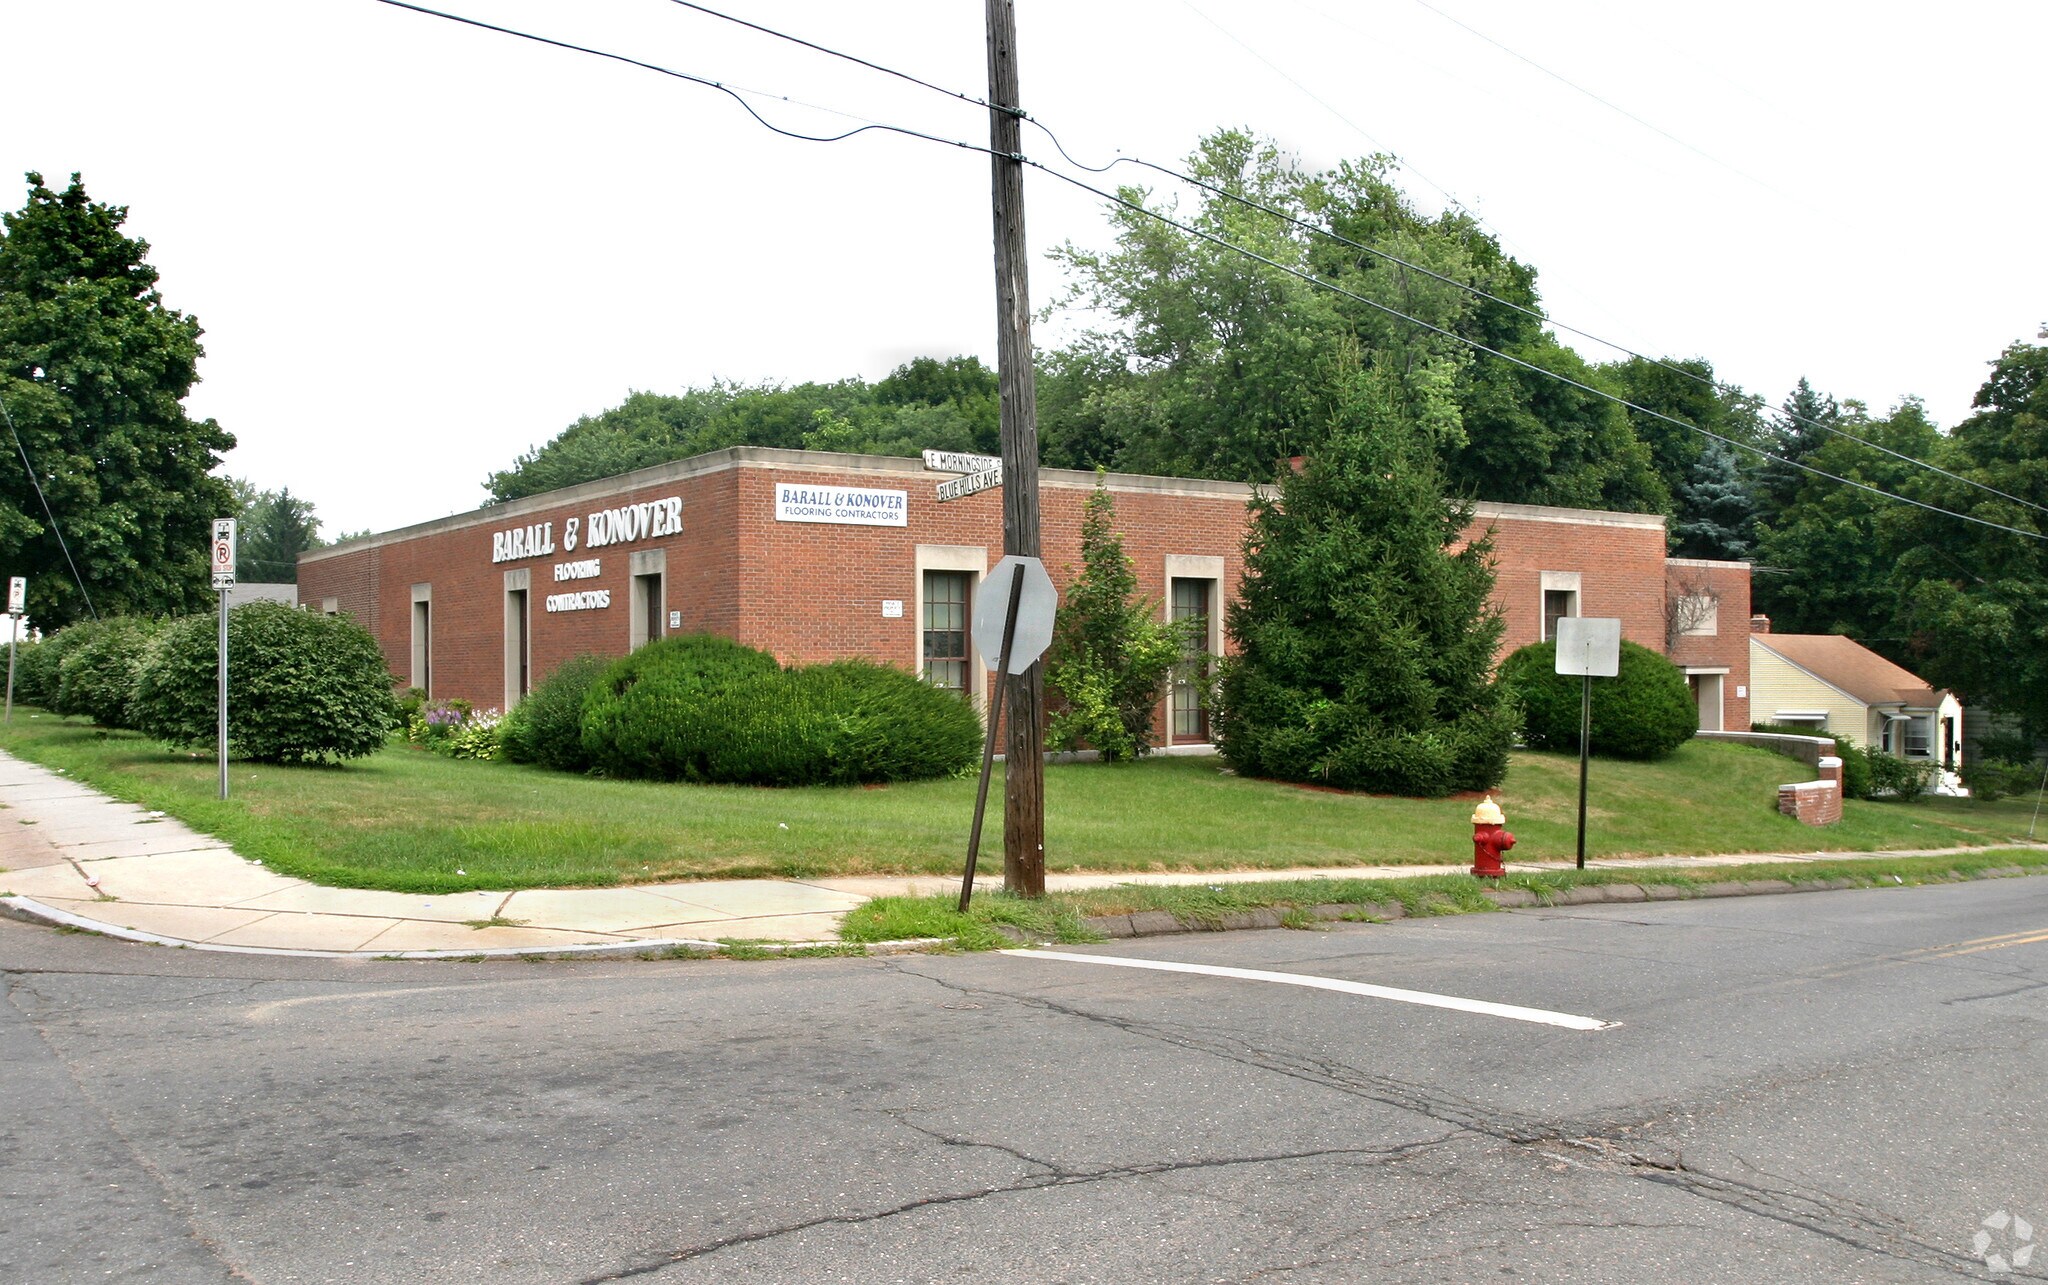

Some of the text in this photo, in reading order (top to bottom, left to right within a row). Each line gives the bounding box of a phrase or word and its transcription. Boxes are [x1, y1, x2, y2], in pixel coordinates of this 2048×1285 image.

[940, 453, 992, 472] MORNINGSIDE
[781, 489, 903, 509] BARALL & KONOVER
[939, 481, 958, 500] BLUE
[960, 474, 981, 494] HILLS
[785, 506, 899, 521] FLOORING CONTRACTORS
[492, 496, 684, 564] BARALL & KONOVER
[554, 558, 601, 582] FLOORING
[546, 589, 611, 613] CONTRACTORS
